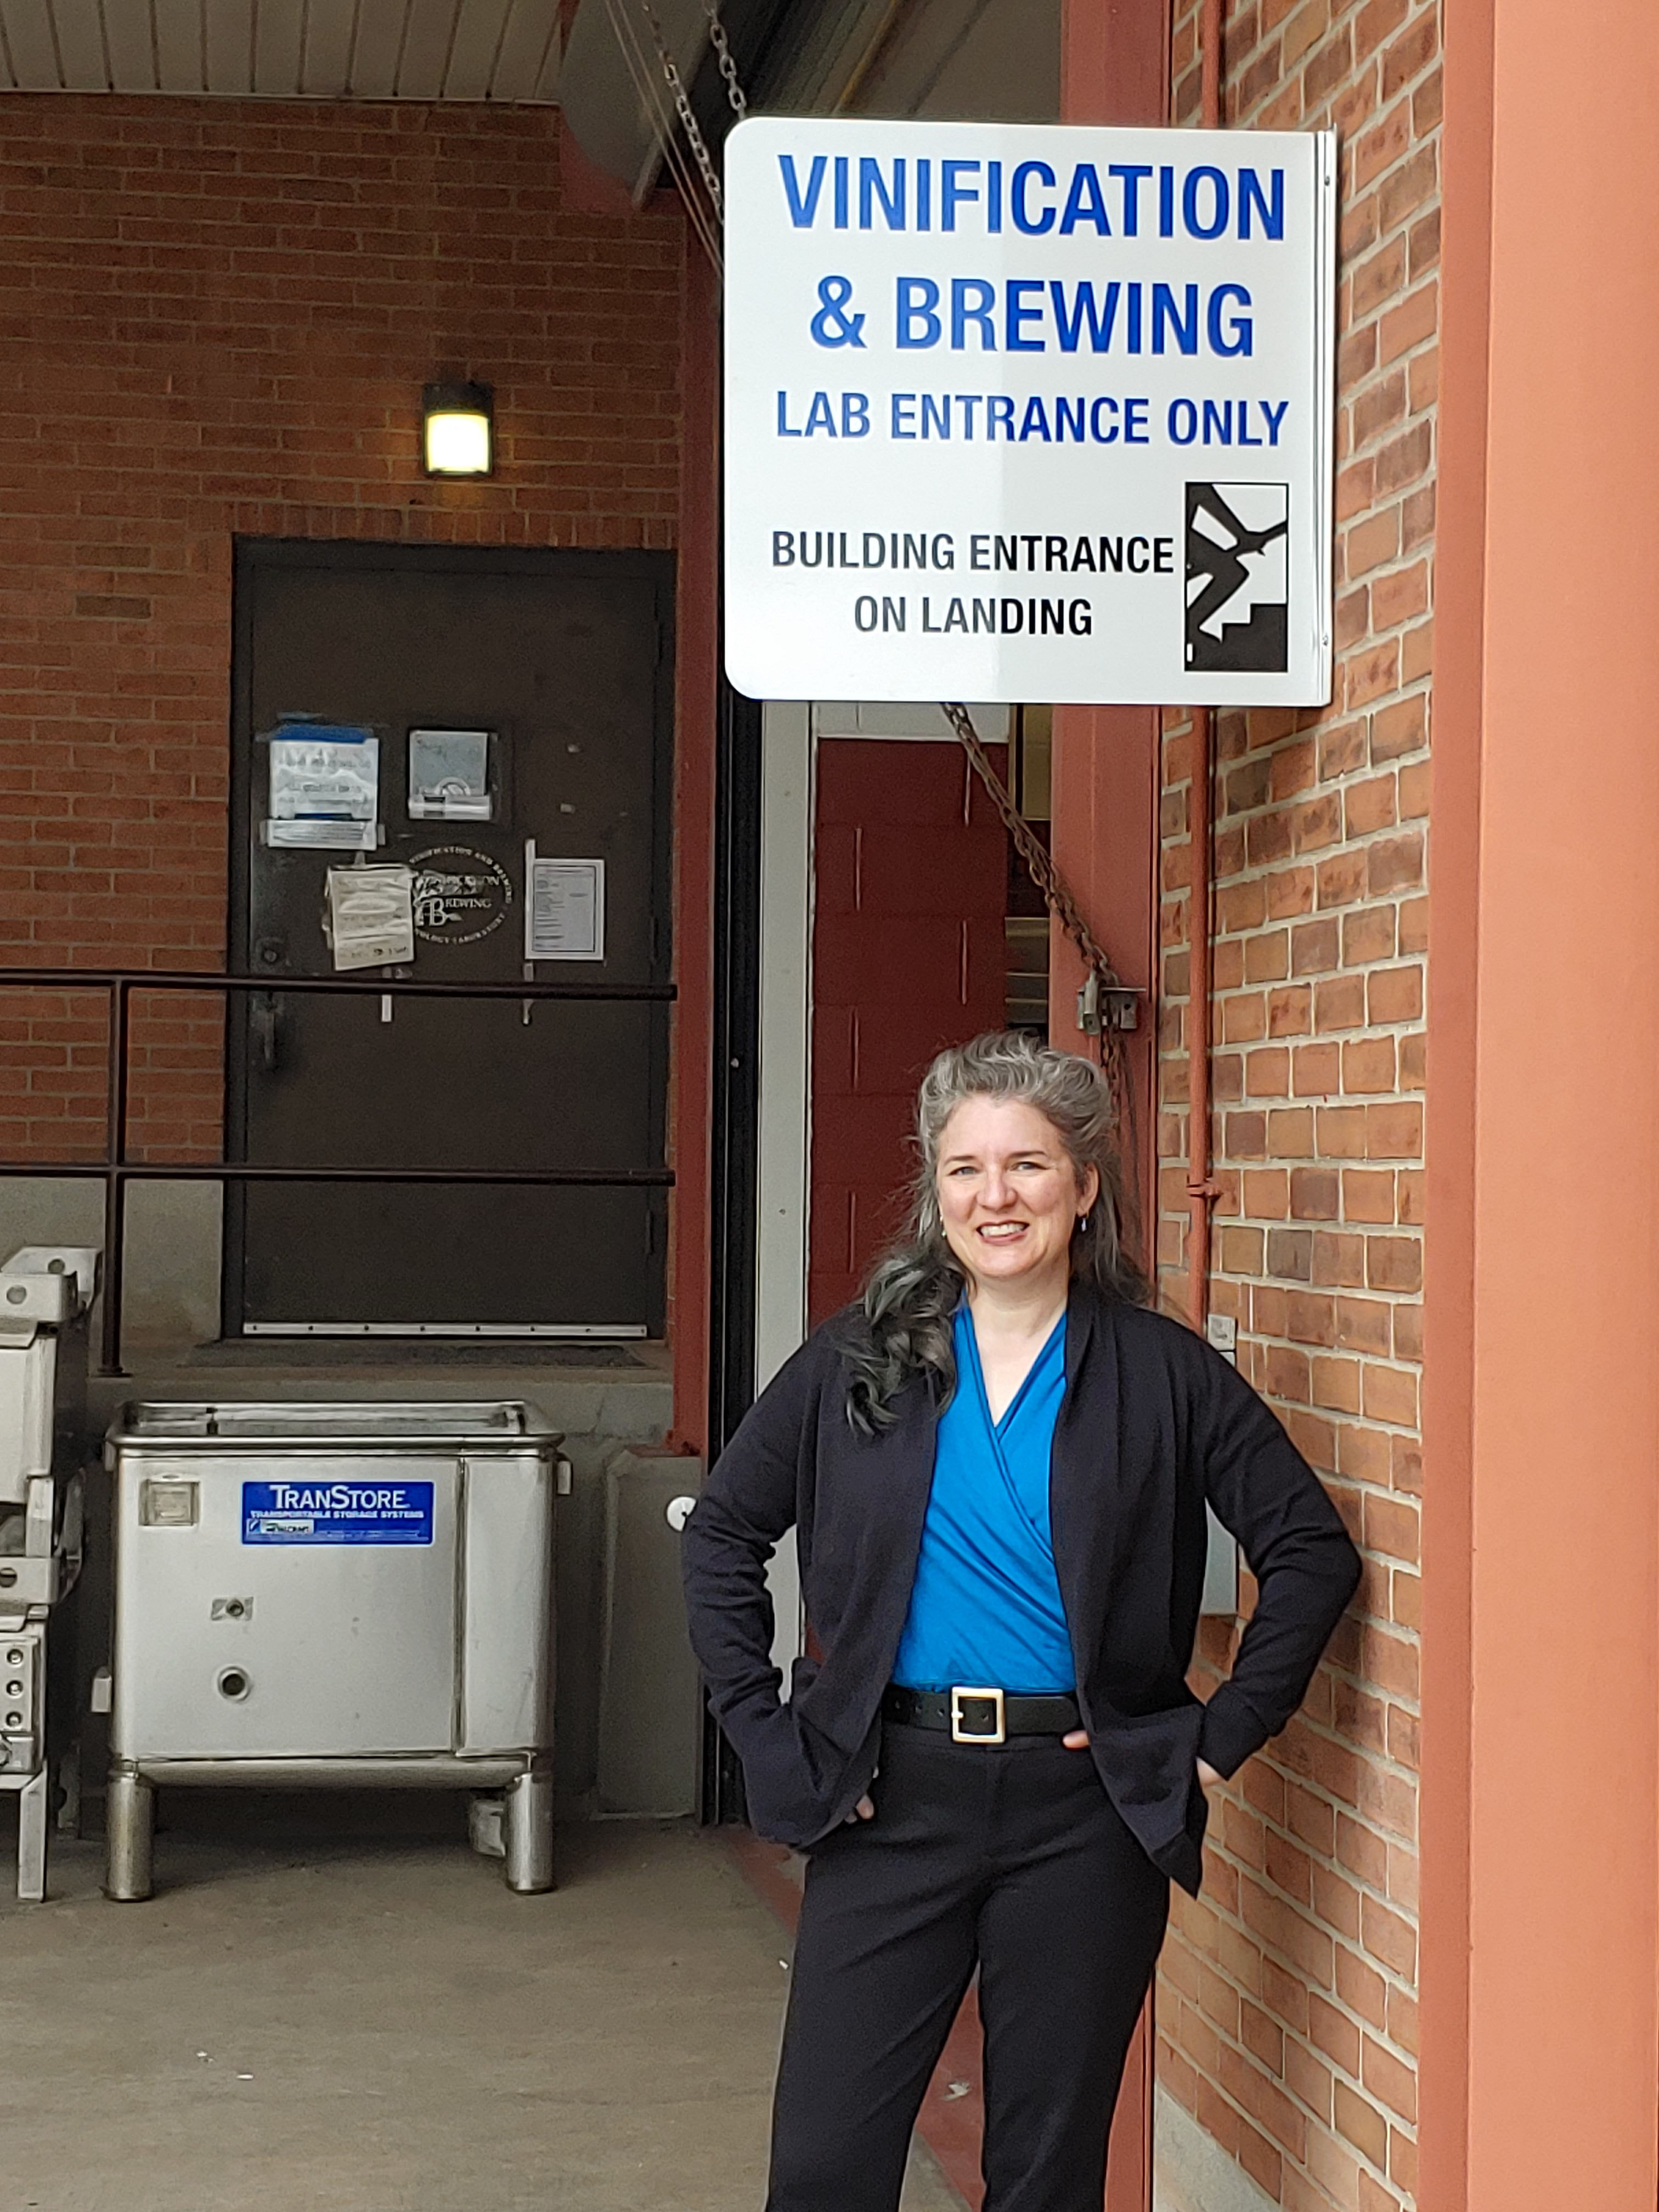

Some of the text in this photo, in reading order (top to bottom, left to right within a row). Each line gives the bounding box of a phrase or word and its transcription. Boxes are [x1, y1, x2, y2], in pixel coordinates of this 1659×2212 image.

[778, 154, 1284, 241] VINIFICATION
[810, 275, 1253, 358] & BREWING
[777, 391, 1289, 447] LAB ENTRANCE ONLY
[772, 531, 1174, 574] BUILDING ENTRANCE
[855, 595, 1092, 636] ON LANDING
